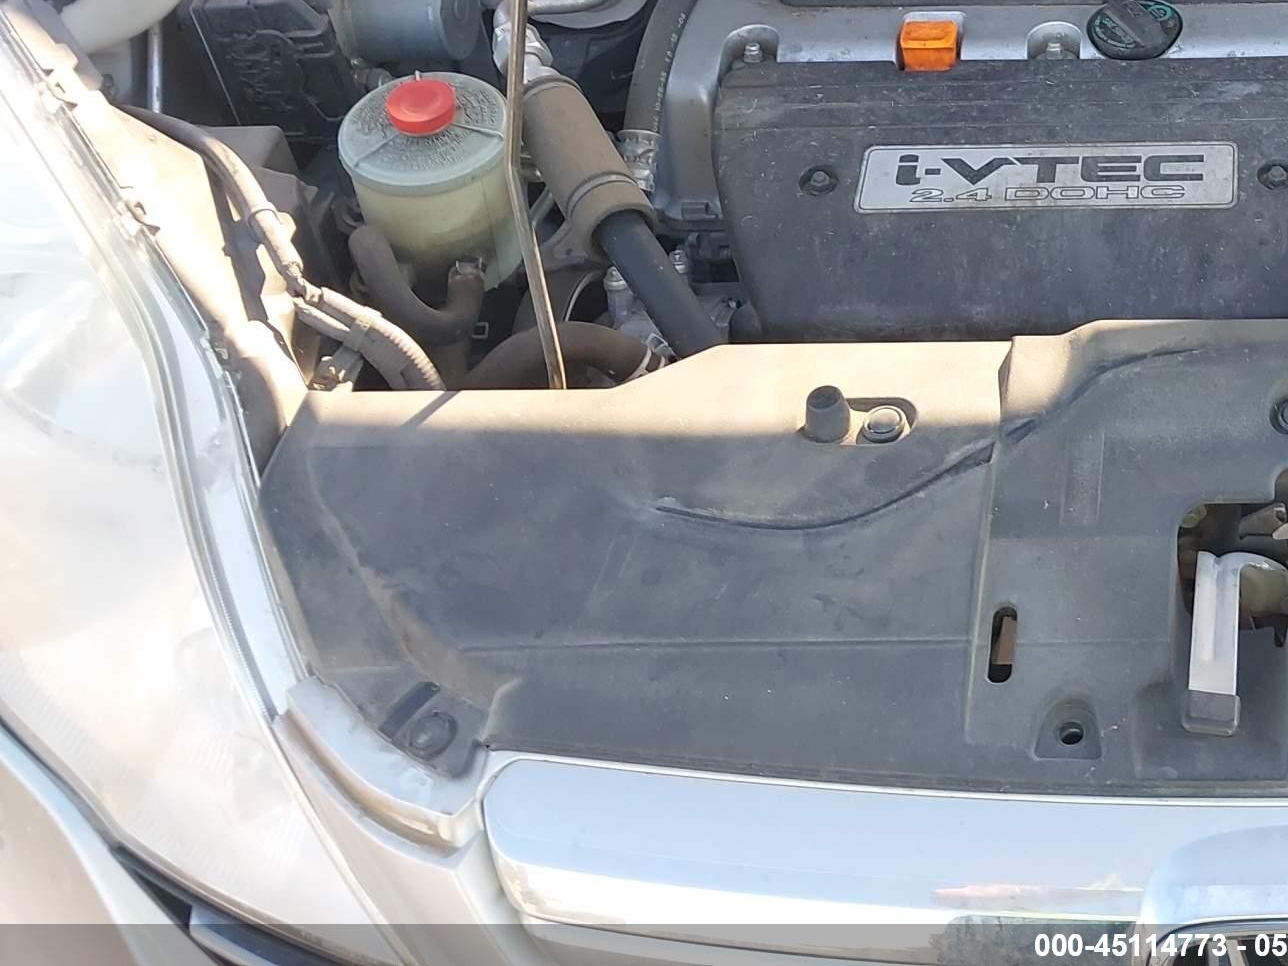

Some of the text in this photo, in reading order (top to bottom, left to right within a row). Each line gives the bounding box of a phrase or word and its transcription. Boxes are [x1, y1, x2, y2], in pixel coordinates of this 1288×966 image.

[895, 154, 1205, 186] i-VTEC
[908, 185, 1186, 204] 2.4 DOHC
